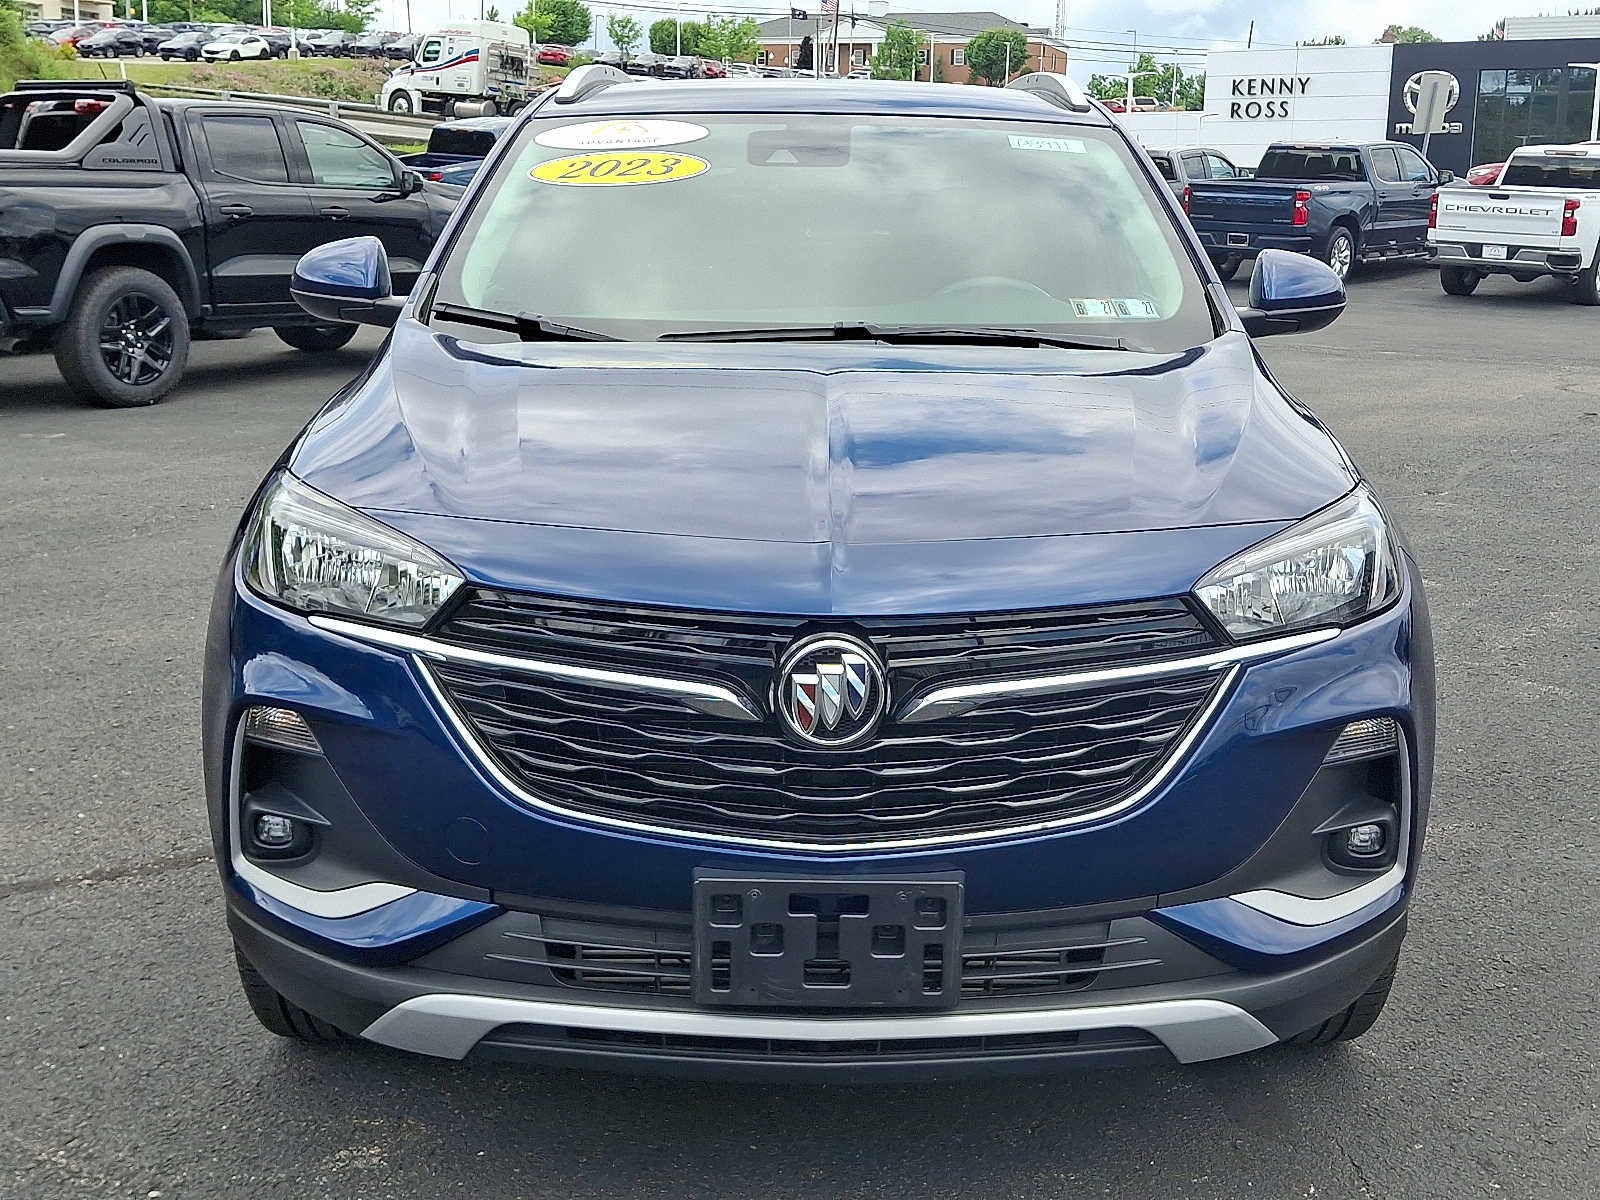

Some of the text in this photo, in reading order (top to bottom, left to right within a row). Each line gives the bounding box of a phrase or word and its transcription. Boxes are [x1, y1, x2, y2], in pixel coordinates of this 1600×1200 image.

[1231, 77, 1311, 96] KENNY
[1230, 100, 1289, 119] ROSS
[1395, 123, 1462, 134] mda
[557, 158, 681, 179] 2023
[1445, 204, 1553, 216] CHEVROLET
